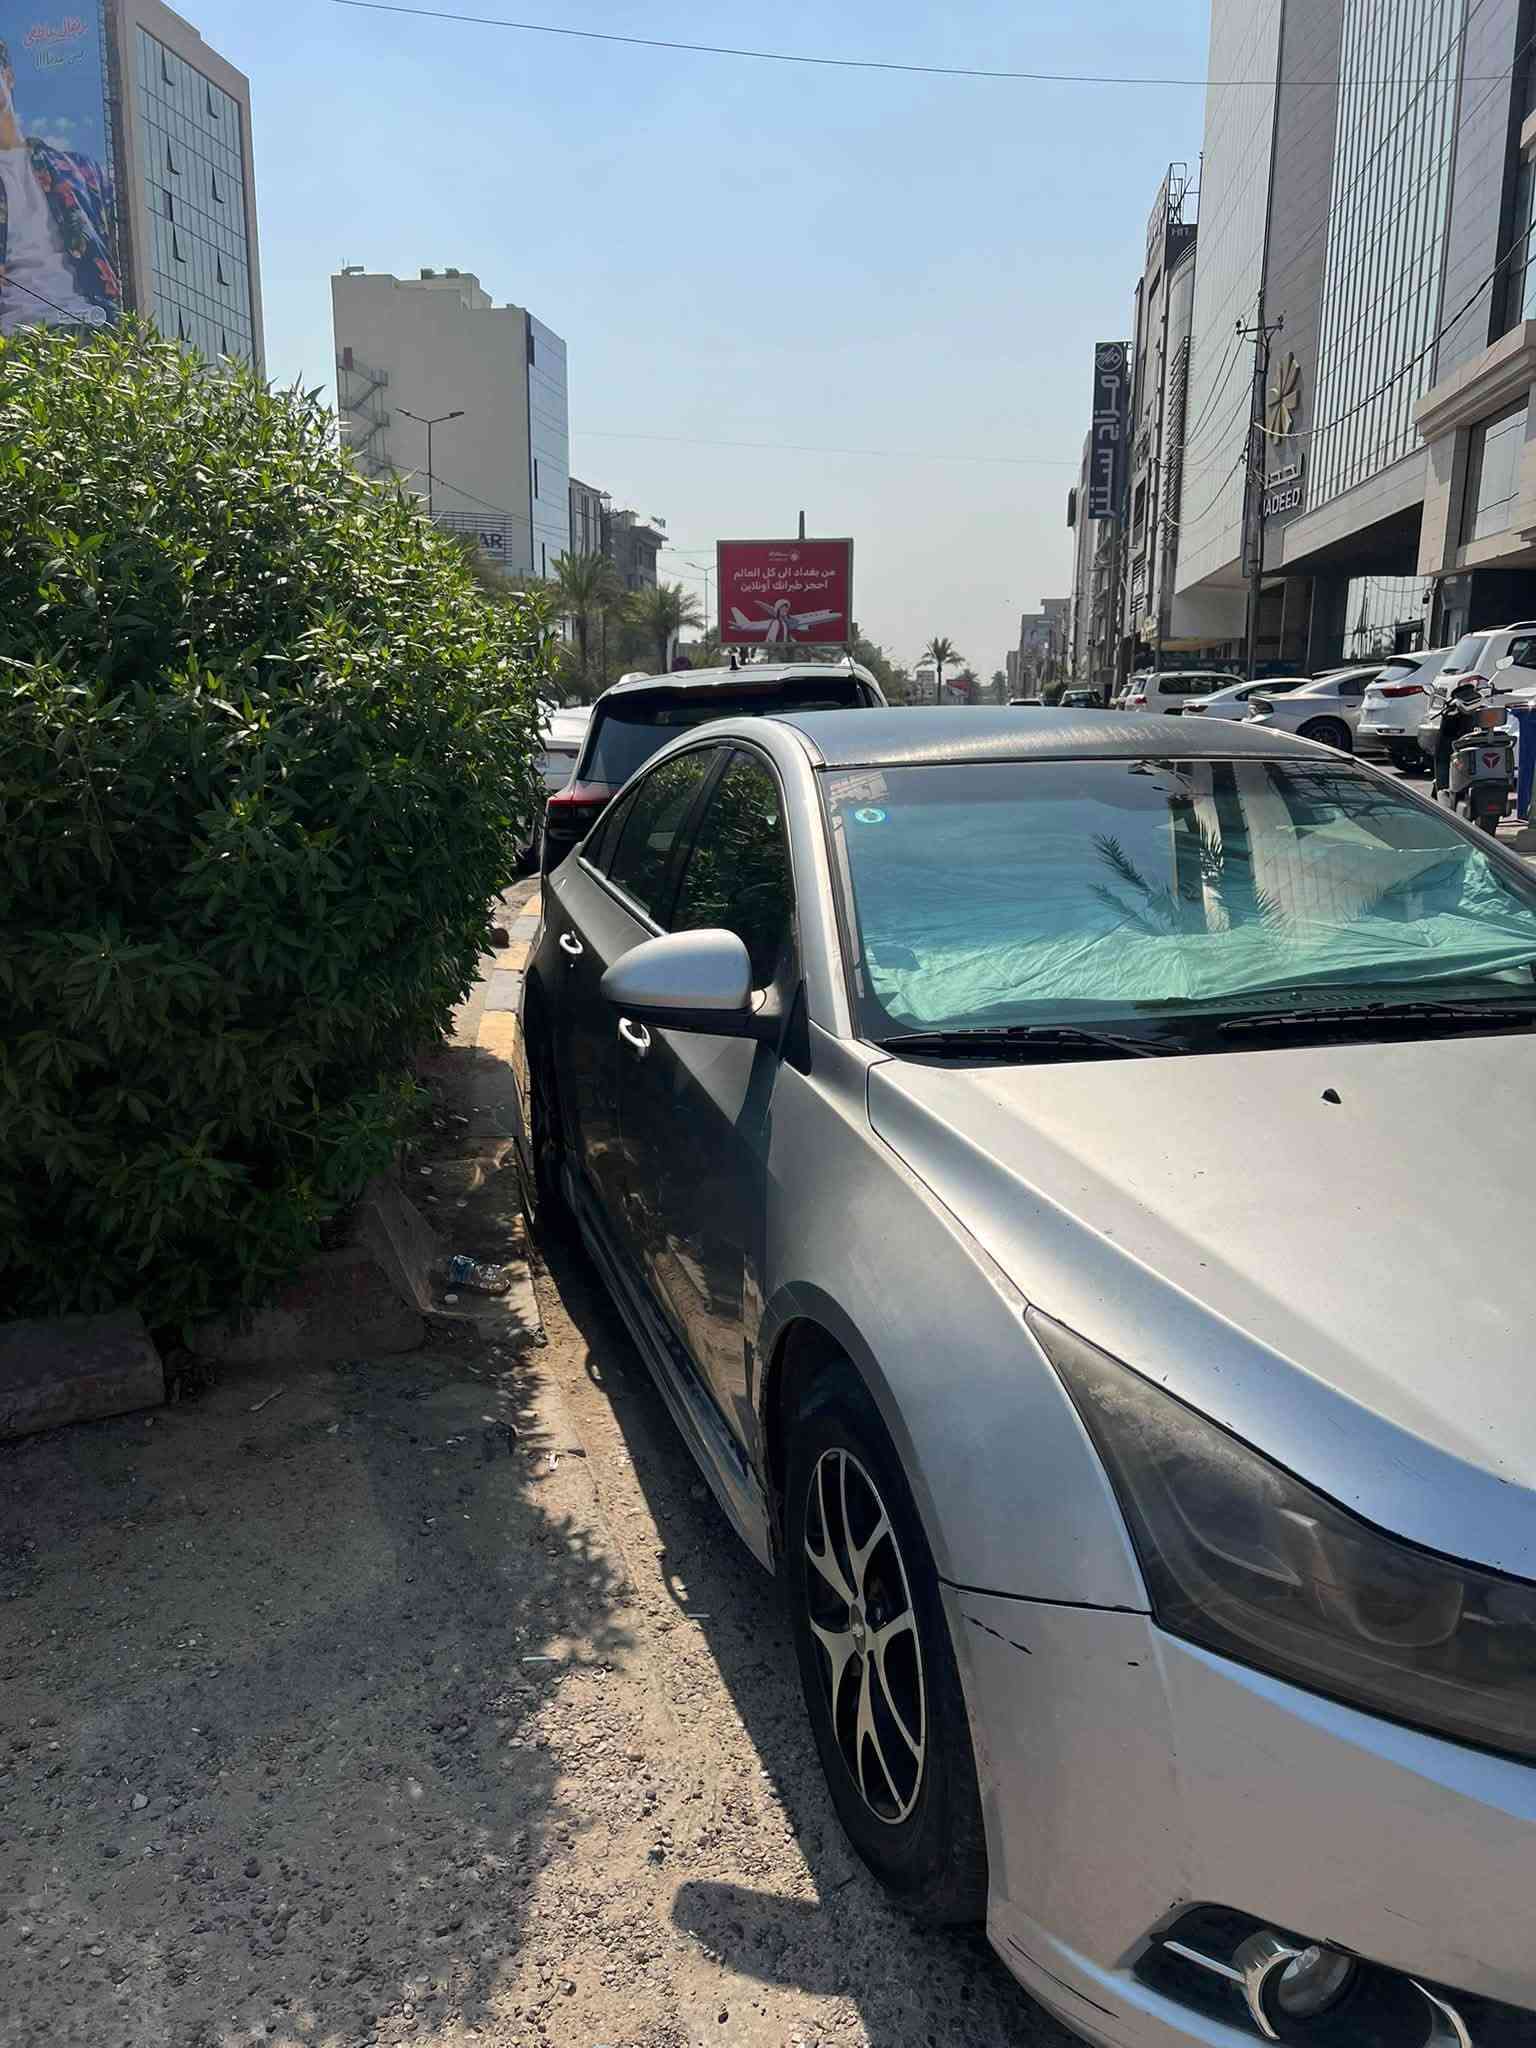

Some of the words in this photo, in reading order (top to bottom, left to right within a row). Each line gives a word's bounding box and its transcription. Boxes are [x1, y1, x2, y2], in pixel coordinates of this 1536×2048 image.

[733, 567, 760, 580] العالم
[762, 567, 776, 579] كل
[793, 567, 819, 578] بغداد
[773, 579, 803, 592] طيرانك
